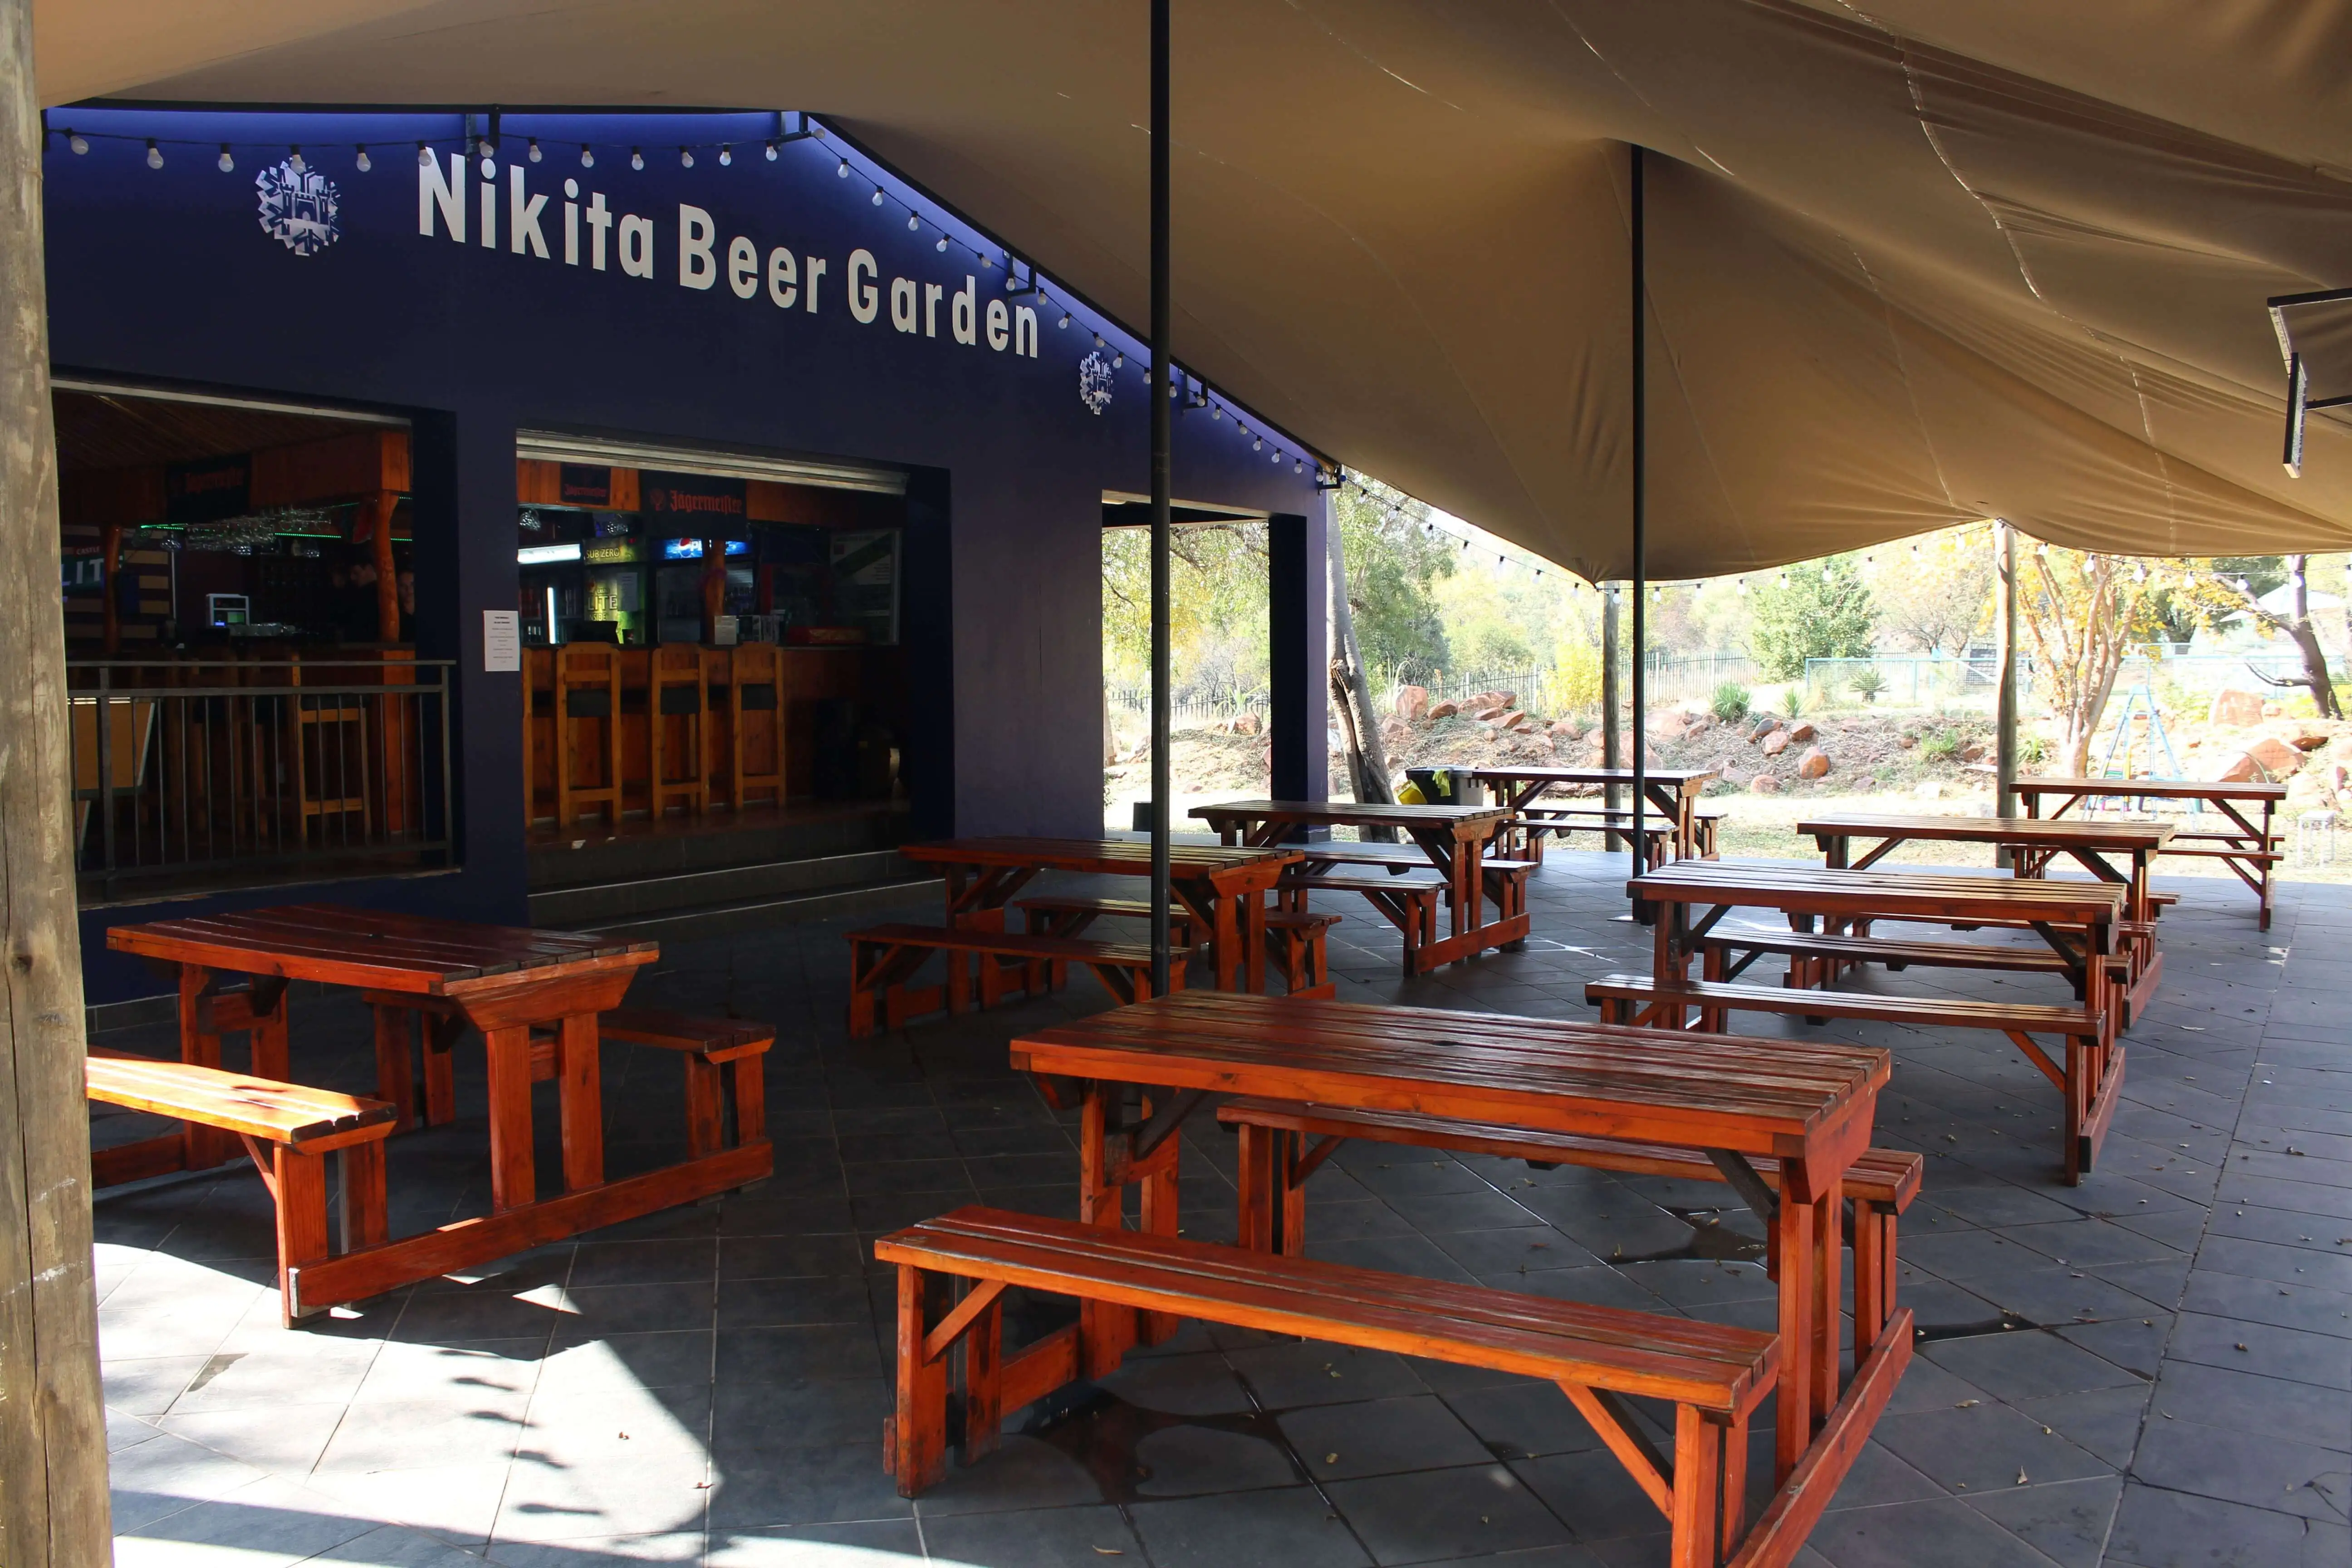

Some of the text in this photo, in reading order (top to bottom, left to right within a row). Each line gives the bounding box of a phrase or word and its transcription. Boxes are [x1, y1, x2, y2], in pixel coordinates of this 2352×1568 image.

[419, 146, 1038, 358] Nikita Beer Garden
[586, 547, 620, 559] SUB ZERO
[61, 555, 123, 585] LIT
[588, 595, 617, 610] LITE
